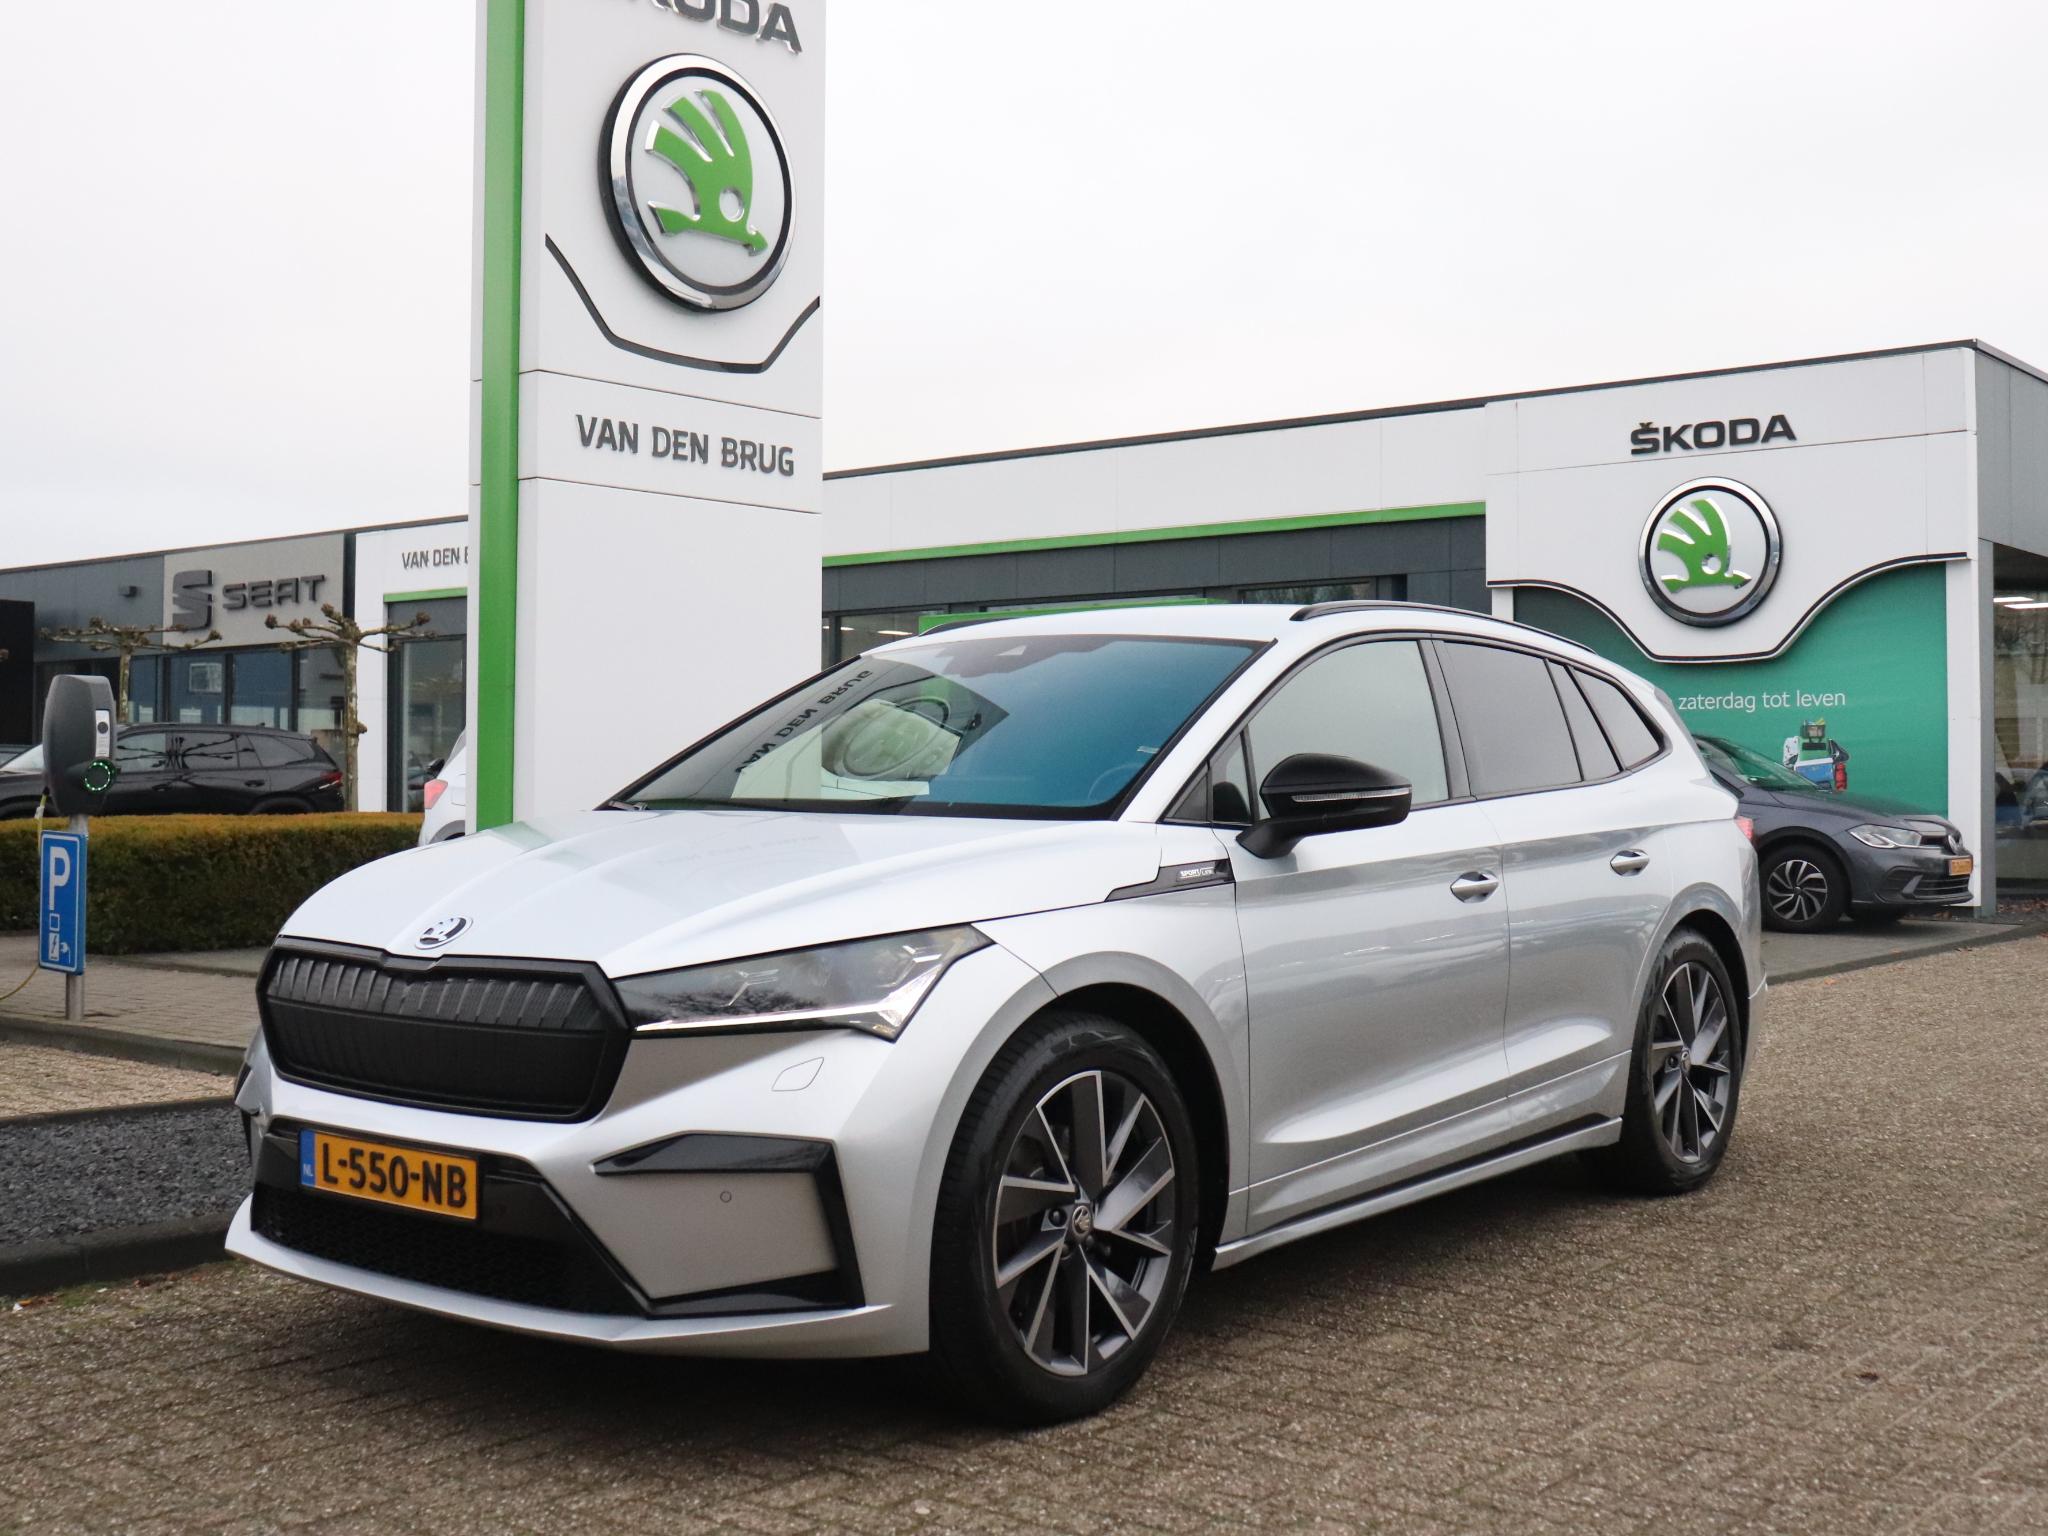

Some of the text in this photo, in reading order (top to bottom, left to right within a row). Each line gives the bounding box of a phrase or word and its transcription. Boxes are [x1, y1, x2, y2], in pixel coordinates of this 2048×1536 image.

[652, 0, 802, 54] ODA
[575, 414, 795, 477] VAN DEN BRUG
[1631, 414, 1797, 456] ŠKODA
[401, 550, 429, 570] VAN
[432, 547, 460, 567] DEN
[222, 574, 325, 610] SEAT
[1678, 690, 1846, 713] zaterdag tot leven
[49, 846, 71, 911] P
[303, 1163, 314, 1177] NL
[322, 1142, 467, 1208] L-550-NB
